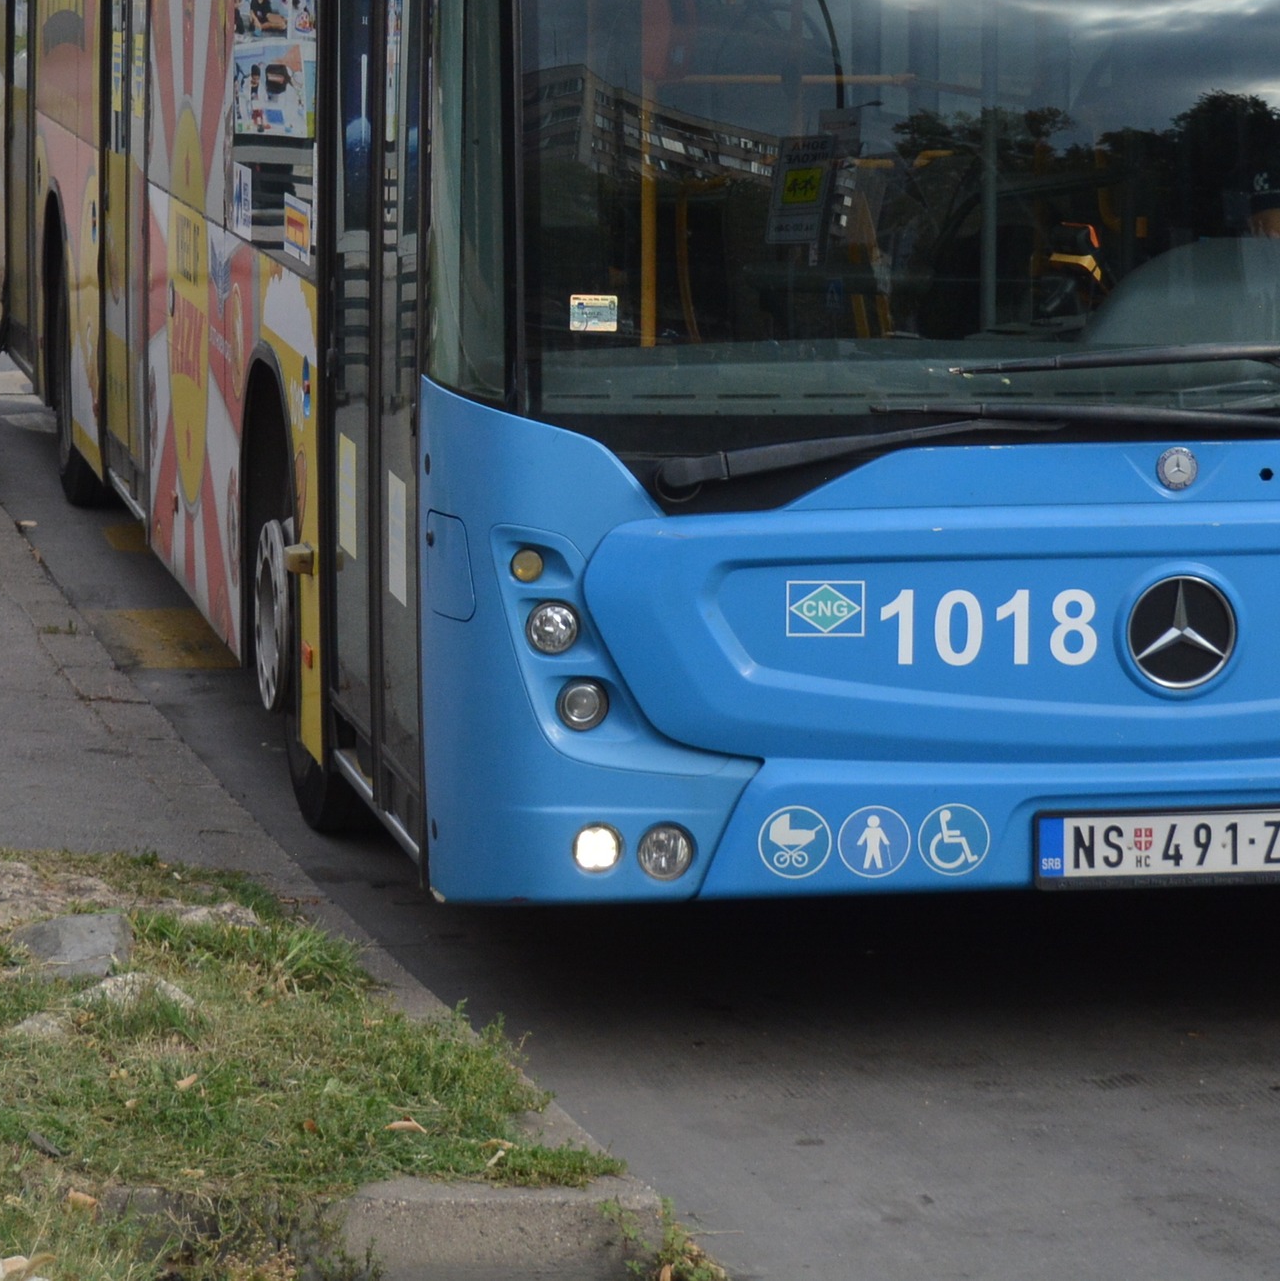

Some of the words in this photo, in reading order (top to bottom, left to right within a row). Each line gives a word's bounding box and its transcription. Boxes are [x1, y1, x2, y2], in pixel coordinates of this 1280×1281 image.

[802, 600, 848, 617] CNG
[880, 589, 1098, 666] 1018
[1073, 825, 1124, 869] NS
[1041, 857, 1061, 870] SRB
